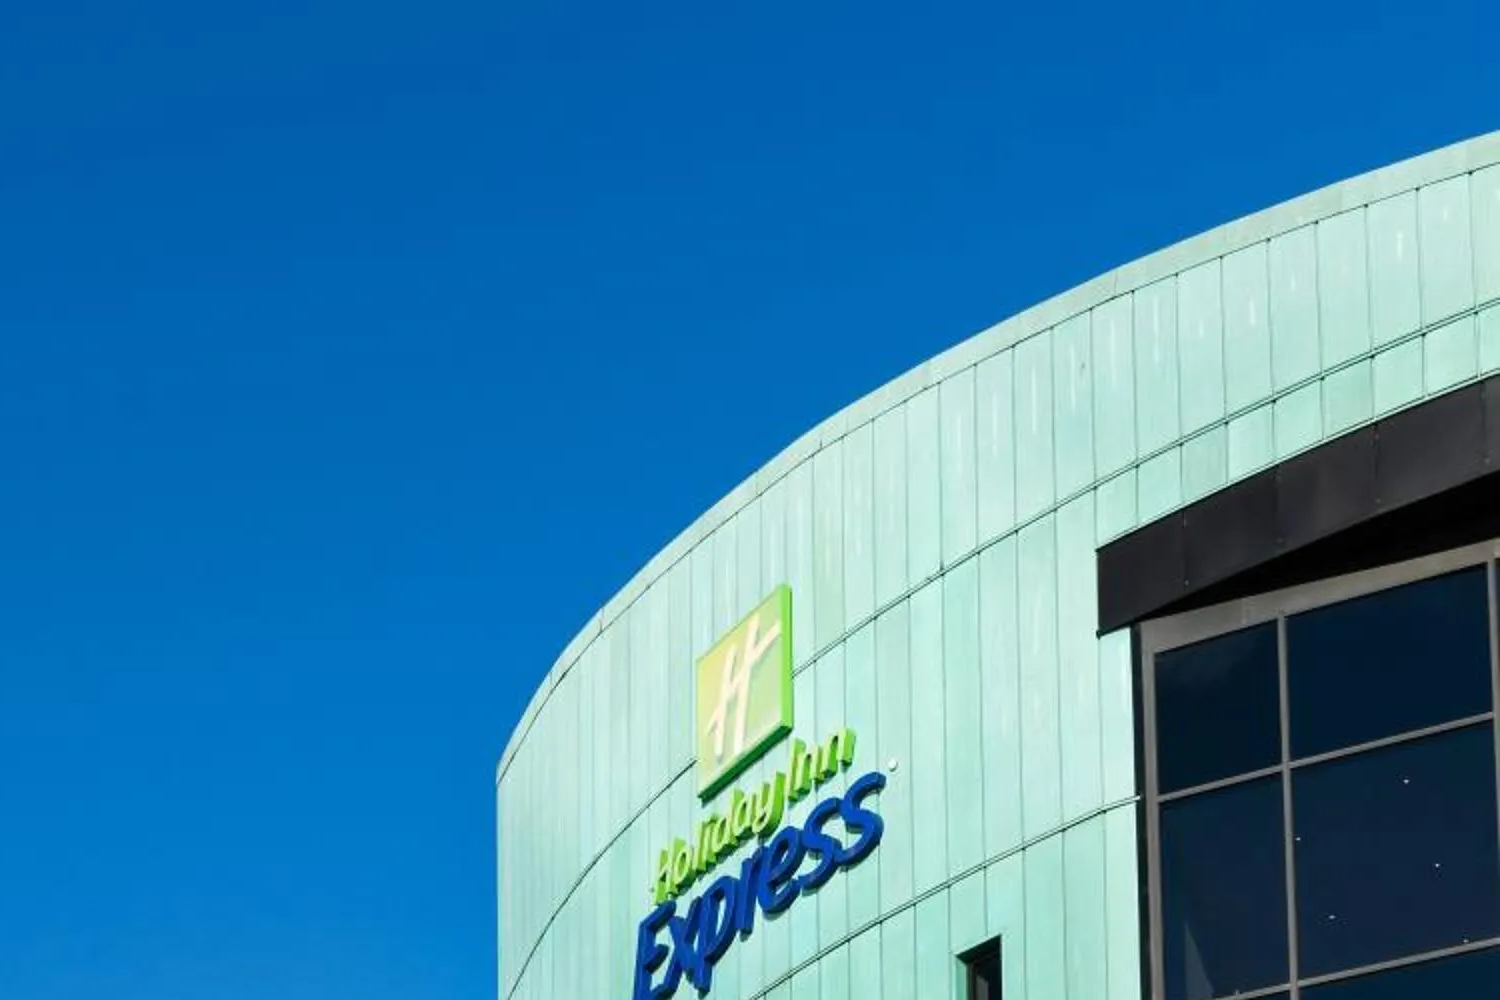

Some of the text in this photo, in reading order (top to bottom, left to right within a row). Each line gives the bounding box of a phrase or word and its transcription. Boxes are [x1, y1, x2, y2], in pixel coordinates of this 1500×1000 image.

[707, 612, 782, 757] H
[653, 727, 856, 905] Holiday Inn
